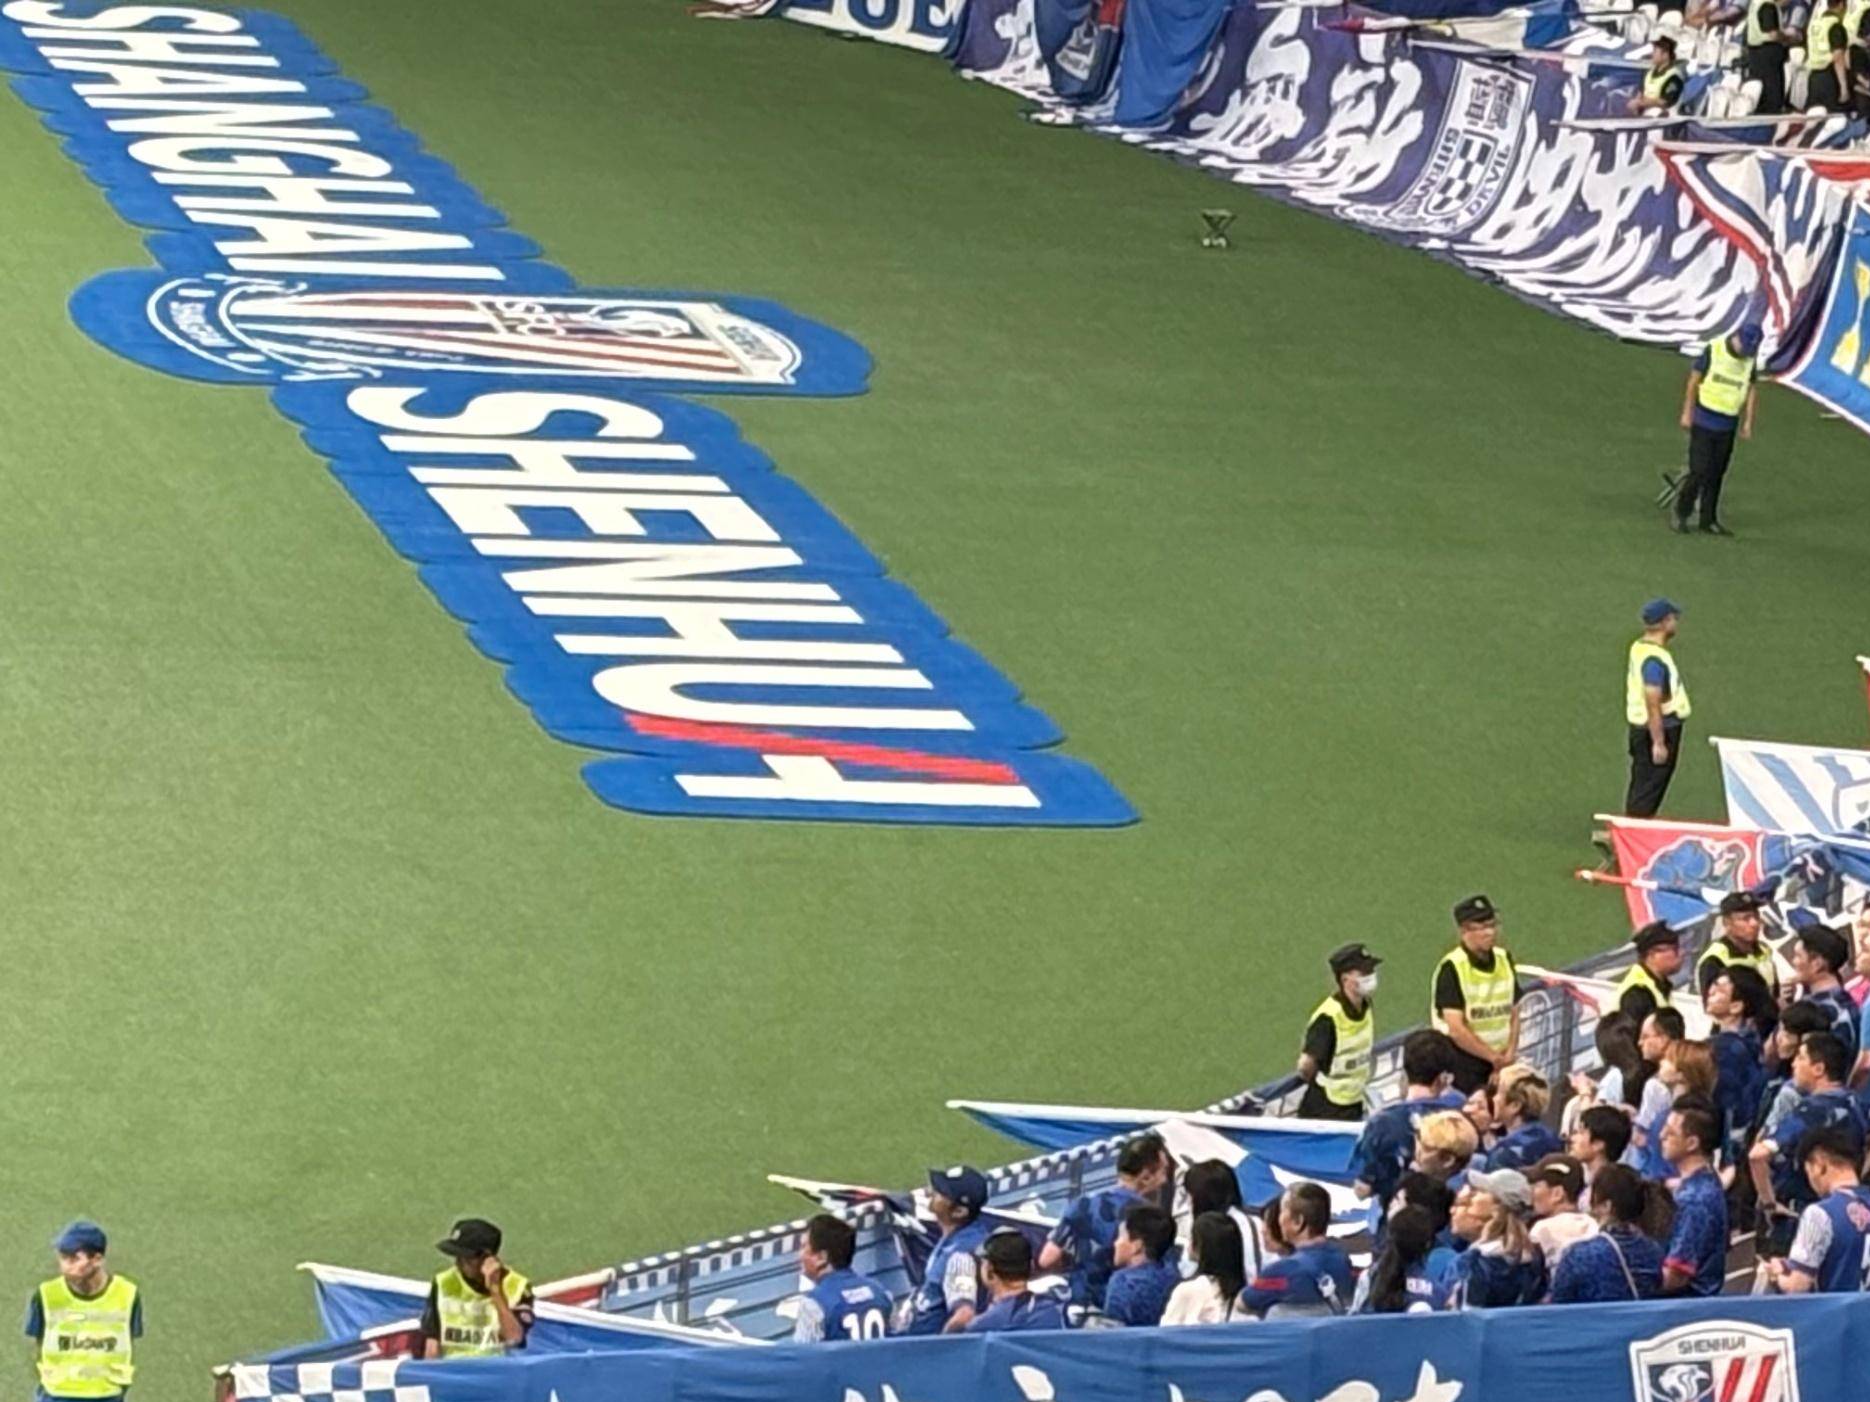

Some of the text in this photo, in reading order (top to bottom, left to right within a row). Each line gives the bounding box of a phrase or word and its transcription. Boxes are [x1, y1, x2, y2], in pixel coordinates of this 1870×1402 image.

[0, 0, 507, 281] SHANGHAI
[345, 386, 1043, 808] SHENHUA
[1677, 1336, 1747, 1355] SHENHUA
